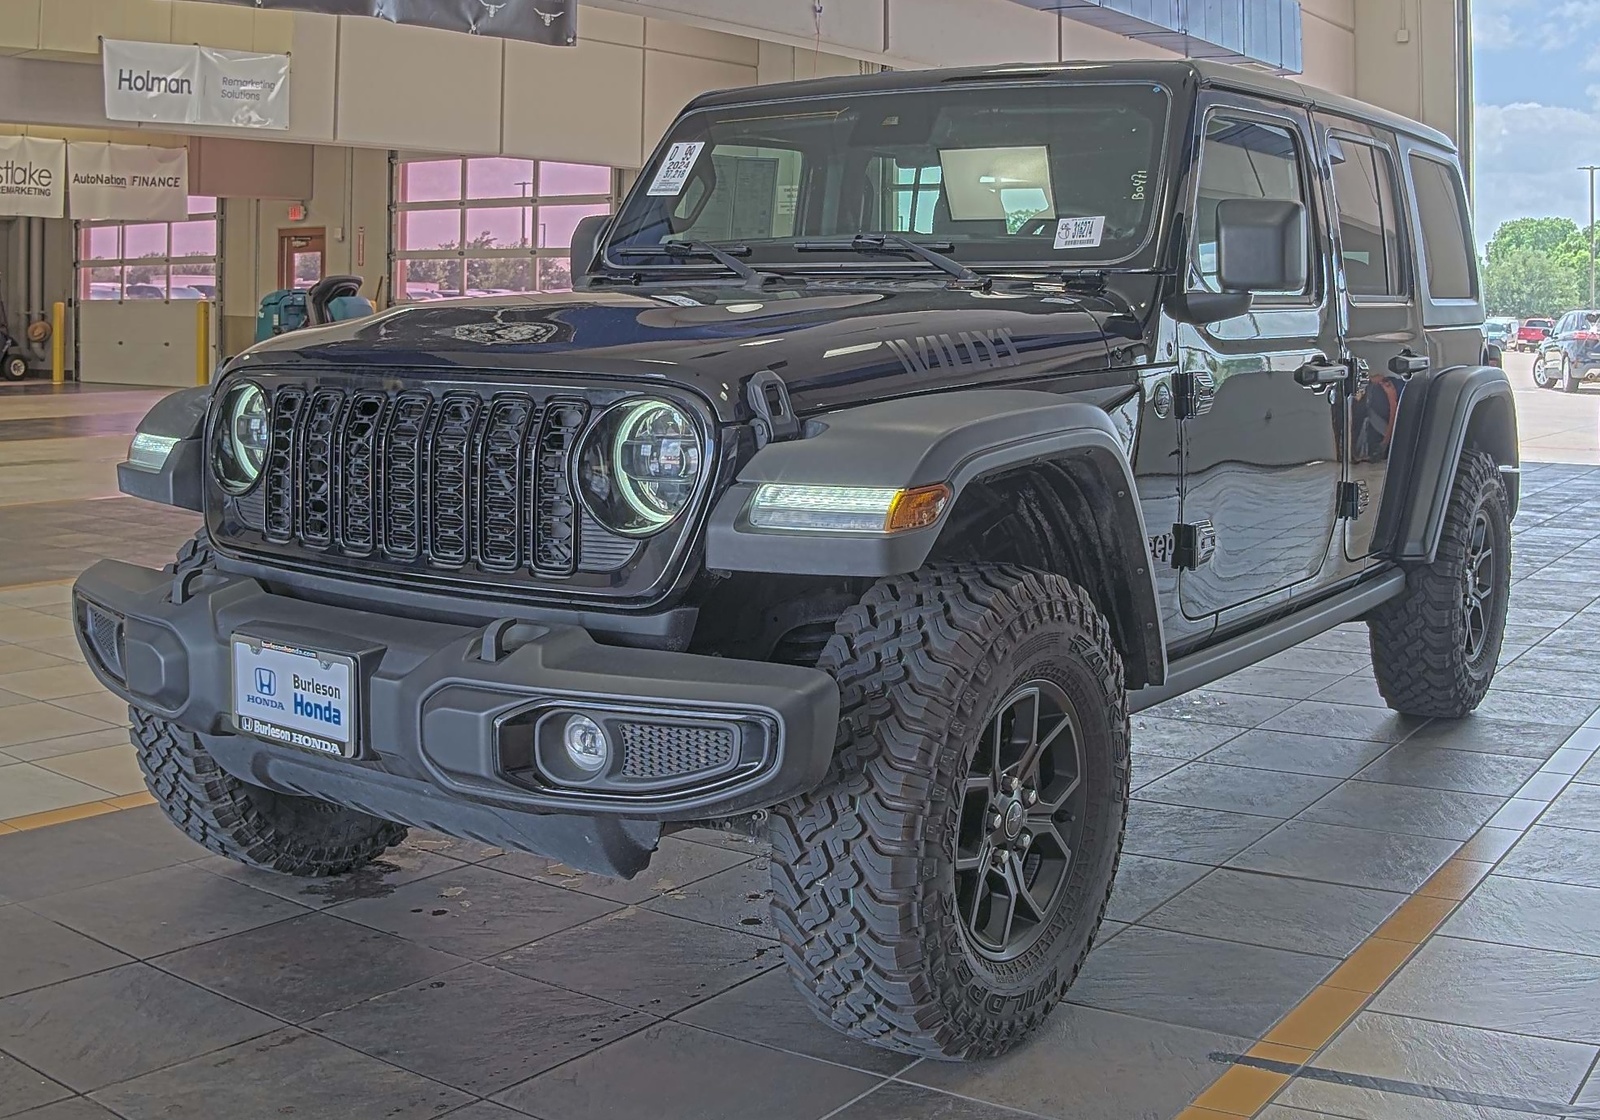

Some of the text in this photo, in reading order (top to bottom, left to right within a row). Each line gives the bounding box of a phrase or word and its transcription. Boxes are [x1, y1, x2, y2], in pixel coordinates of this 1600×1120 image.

[118, 69, 192, 95] Holman
[221, 77, 276, 93] Remarketing
[221, 90, 261, 101] Solutions
[667, 161, 690, 170] 2024
[72, 173, 181, 188] AutoNation FINANCE
[0, 186, 52, 197] EMARKETING
[1148, 533, 1176, 563] eep
[292, 673, 341, 699] Burleson
[247, 695, 285, 710] HONDA
[293, 692, 342, 726] Honda
[253, 720, 342, 755] Burleson HONDA
